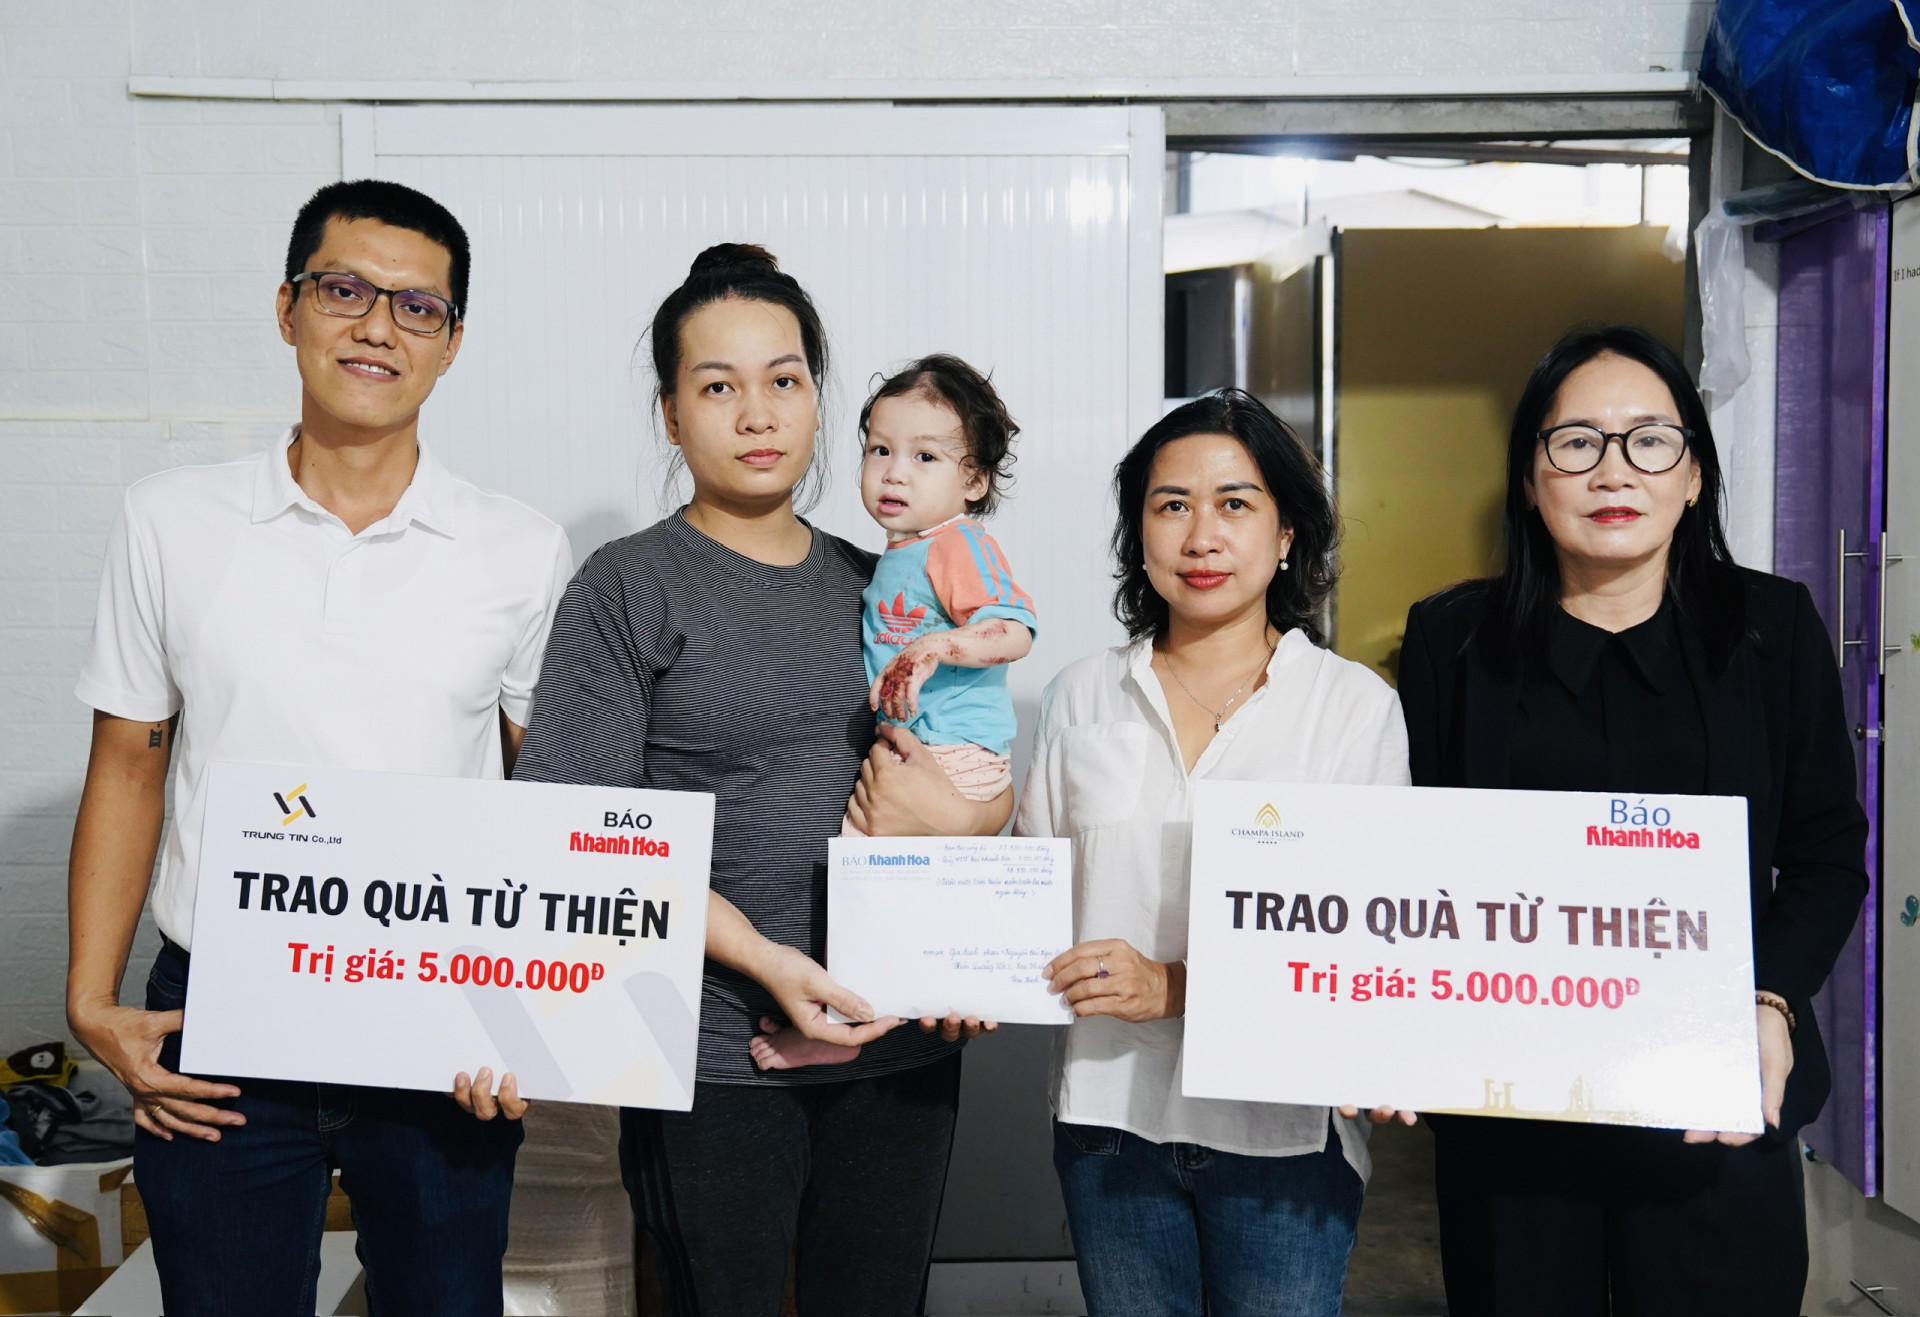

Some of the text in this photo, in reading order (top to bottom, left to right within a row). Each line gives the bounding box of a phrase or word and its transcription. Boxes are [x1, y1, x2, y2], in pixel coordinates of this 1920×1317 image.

[873, 632, 914, 646] adida
[604, 809, 652, 830] BÁO
[1611, 799, 1670, 826] Báo
[242, 831, 342, 844] TRUNG TIN Co.,Ltd
[1231, 828, 1269, 837] CHAMPA
[1271, 830, 1304, 838] ISLAND
[842, 854, 867, 866] BÁO
[233, 871, 669, 946] TRAO QUÀ TỪ THIỆN
[1226, 889, 1708, 959] TRAO QUÀ TỪ THIỆN
[288, 942, 334, 982] Trị
[344, 948, 405, 983] giá:
[1288, 961, 1337, 1002] Trị
[1351, 966, 1415, 1002] giá:
